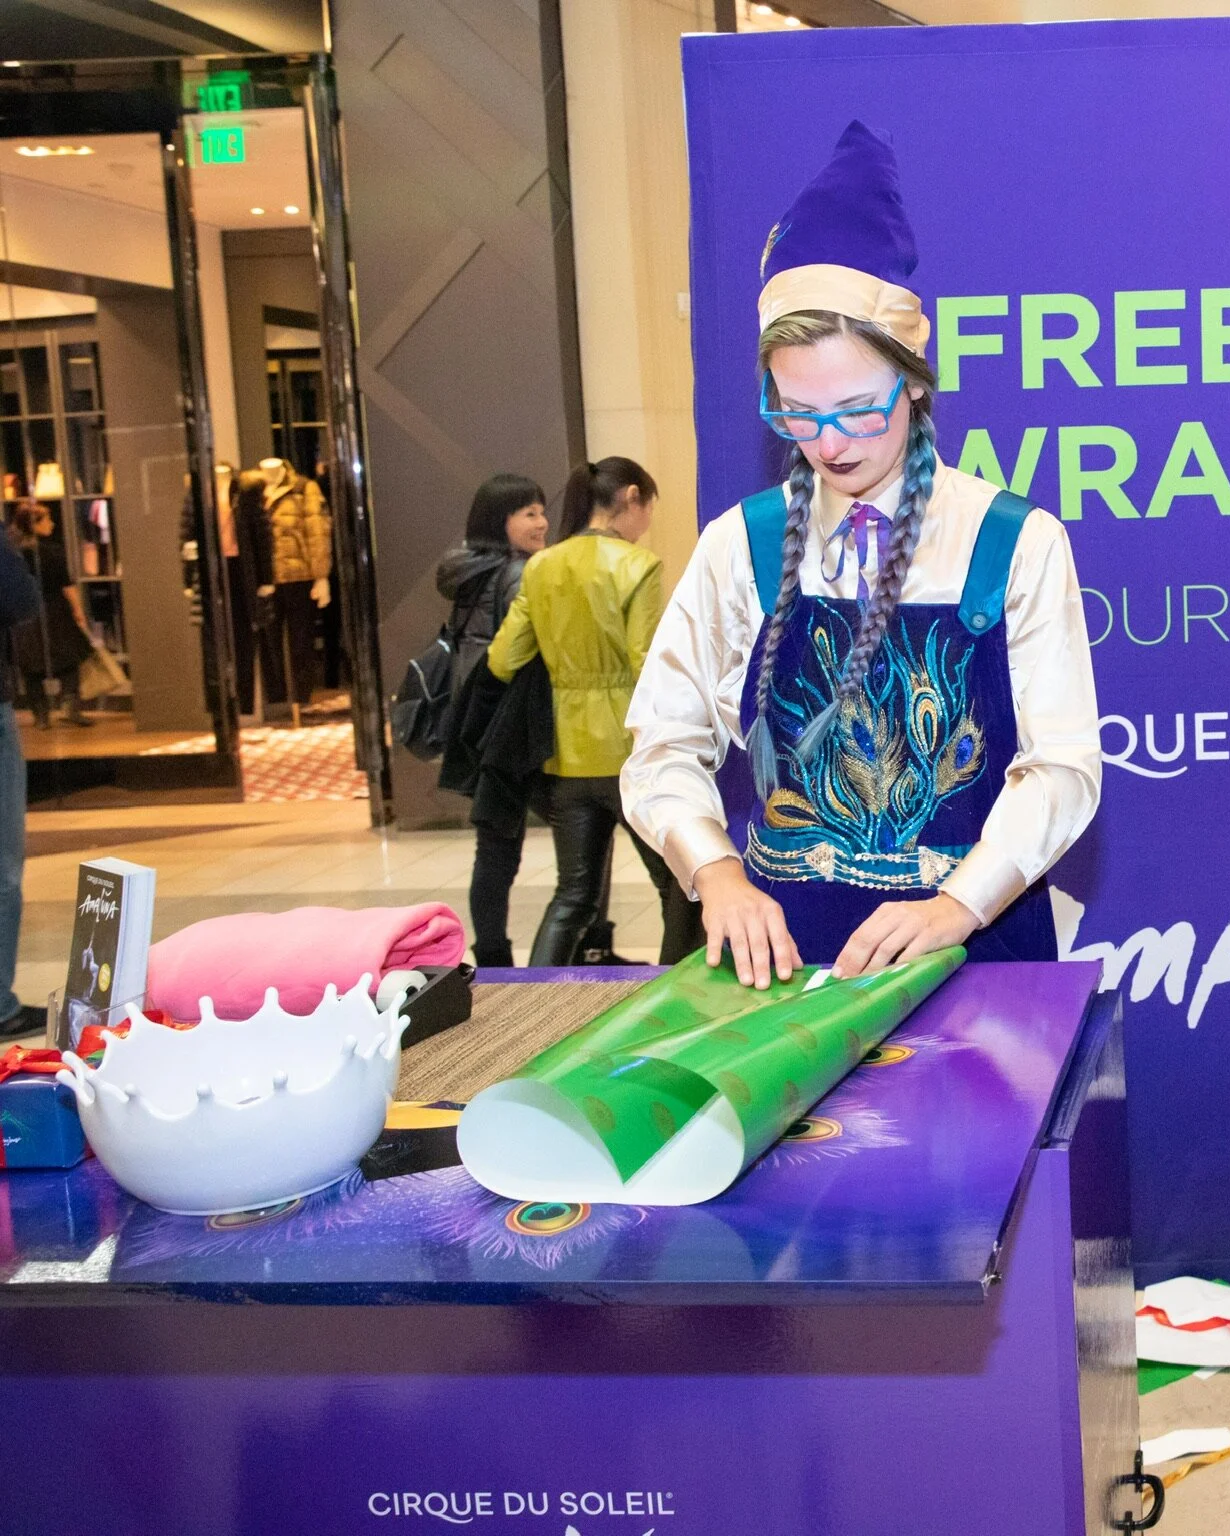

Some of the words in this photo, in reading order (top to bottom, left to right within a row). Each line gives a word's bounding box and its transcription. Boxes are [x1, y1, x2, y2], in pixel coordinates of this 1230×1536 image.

[1098, 711, 1230, 779] QUE
[367, 1491, 494, 1524] CIRQUE
[503, 1491, 549, 1516] DU
